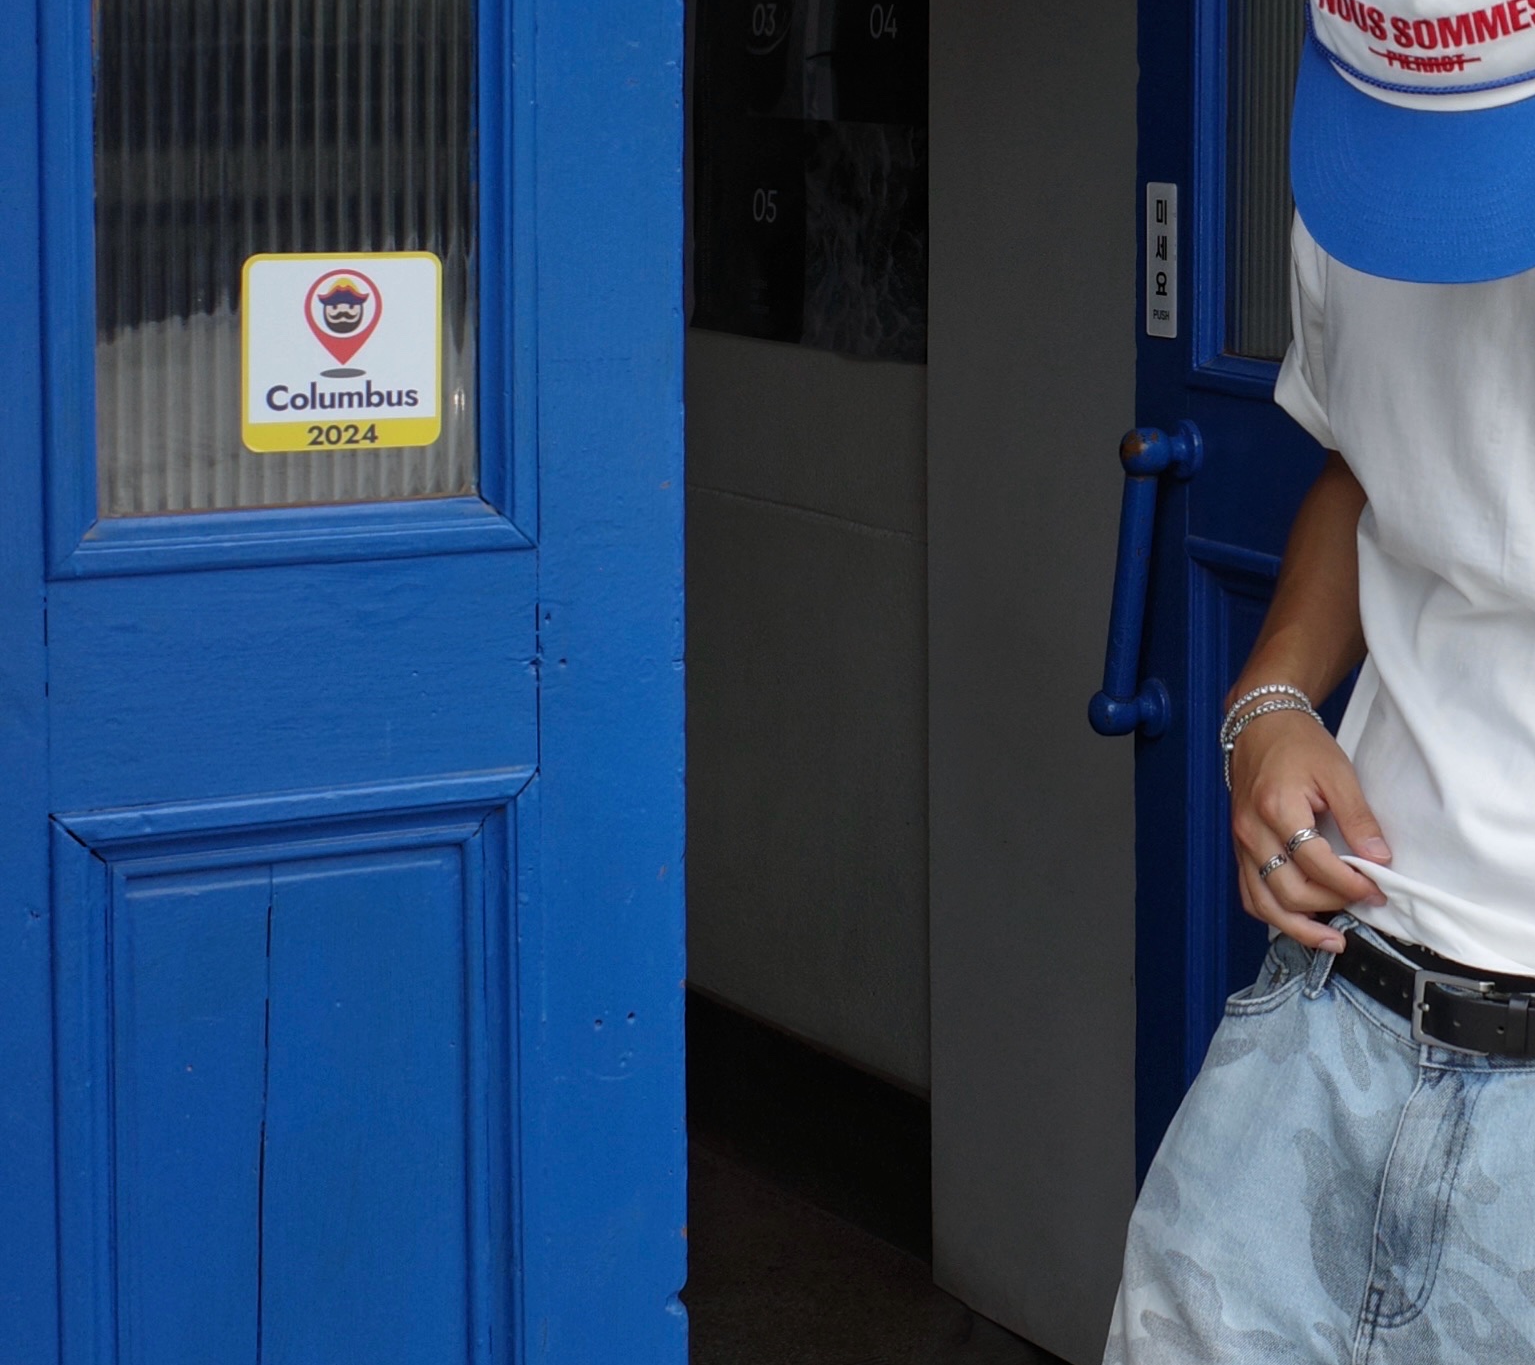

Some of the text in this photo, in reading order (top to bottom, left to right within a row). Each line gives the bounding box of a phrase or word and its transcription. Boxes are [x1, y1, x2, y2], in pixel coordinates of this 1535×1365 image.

[752, 3, 776, 37] 03
[869, 3, 898, 39] 04
[752, 188, 778, 223] 05
[1155, 199, 1168, 296] 미세요
[1152, 308, 1170, 321] PUSH
[265, 380, 419, 412] Columbus
[307, 424, 379, 446] 2024
